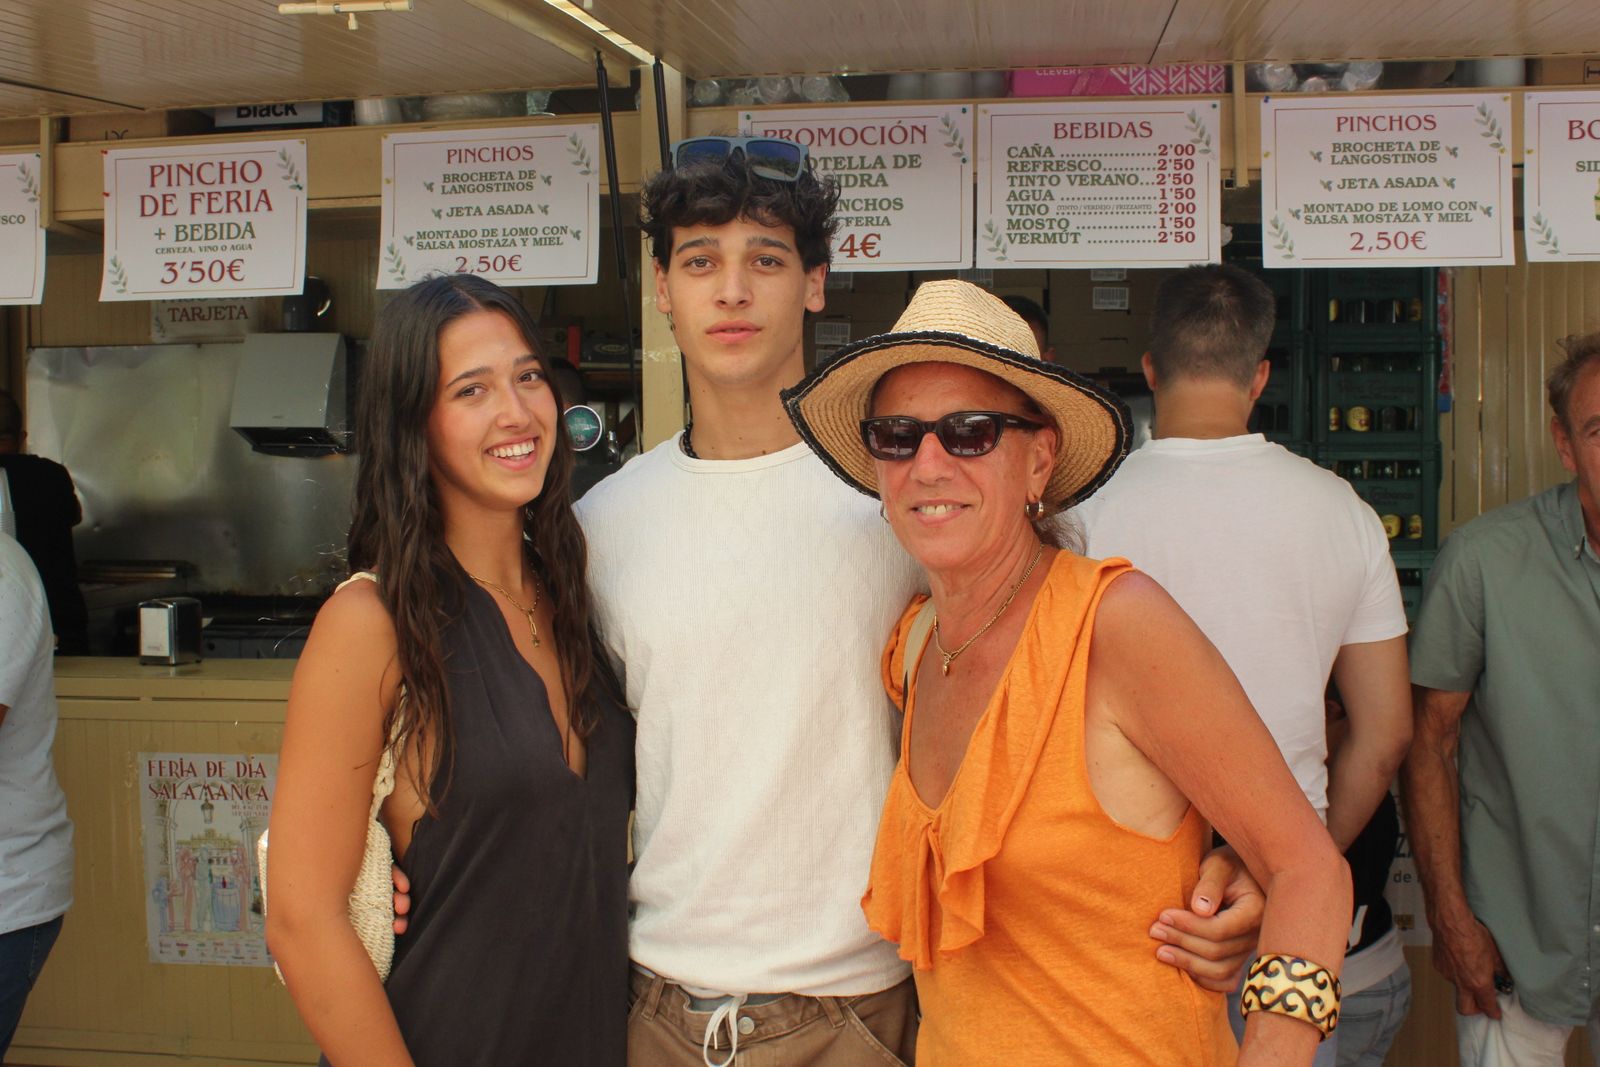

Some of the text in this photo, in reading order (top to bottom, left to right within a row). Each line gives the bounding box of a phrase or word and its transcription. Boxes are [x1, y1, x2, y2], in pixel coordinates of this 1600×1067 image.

[1053, 121, 1153, 139] BEBIDAS
[1336, 114, 1437, 132] PINCHOS
[447, 145, 534, 164] PINCHOS
[1007, 143, 1196, 158] CAÑA 2'00
[1332, 141, 1441, 153] BROCHETA DE
[809, 154, 922, 171] OTELLA DE
[1007, 158, 1195, 173] REFRESCO 2'50
[1331, 153, 1438, 165] LANGOSTINOS
[149, 159, 262, 188] PINCHO
[442, 170, 537, 184] BROCHETA DE
[1007, 173, 1194, 187] TINTO VERANO 2'50
[441, 181, 534, 195] LANGOSTINOS
[1337, 177, 1439, 190] JETA ASADA
[1006, 187, 1196, 201] AGUA 1'50
[140, 189, 273, 217] DE FERIA
[837, 197, 904, 212] NCHOS
[1007, 204, 1049, 216] VINO
[1158, 202, 1196, 215] 2'00
[1304, 201, 1478, 213] MONTADO DE LOMO CON
[446, 204, 534, 218] JETA ASADA
[1304, 213, 1473, 224] SALSA MOSTAZA Y MIEL
[0, 214, 26, 225] SCO
[845, 215, 891, 227] FERIA
[1007, 217, 1196, 231] MOSTO 1'50
[154, 221, 256, 242] + BEBIDA
[416, 225, 569, 240] MONTADO DE LOMO CON
[1006, 229, 1196, 244] VERMÚT 2'50
[198, 244, 218, 253] VINO
[220, 244, 228, 252] O
[229, 243, 253, 252] AGUA
[416, 236, 564, 250] SALSA MOSTAZA Y MIEL
[838, 233, 882, 258] 4€
[1350, 231, 1427, 252] 2,50€
[160, 258, 245, 284] 3'50€
[455, 254, 522, 274] 2,50€
[167, 305, 249, 322] TARJETA
[148, 758, 197, 778] FERIA
[206, 760, 226, 777] DE
[148, 783, 269, 801] SALAMANCA
[1393, 870, 1412, 883] de
